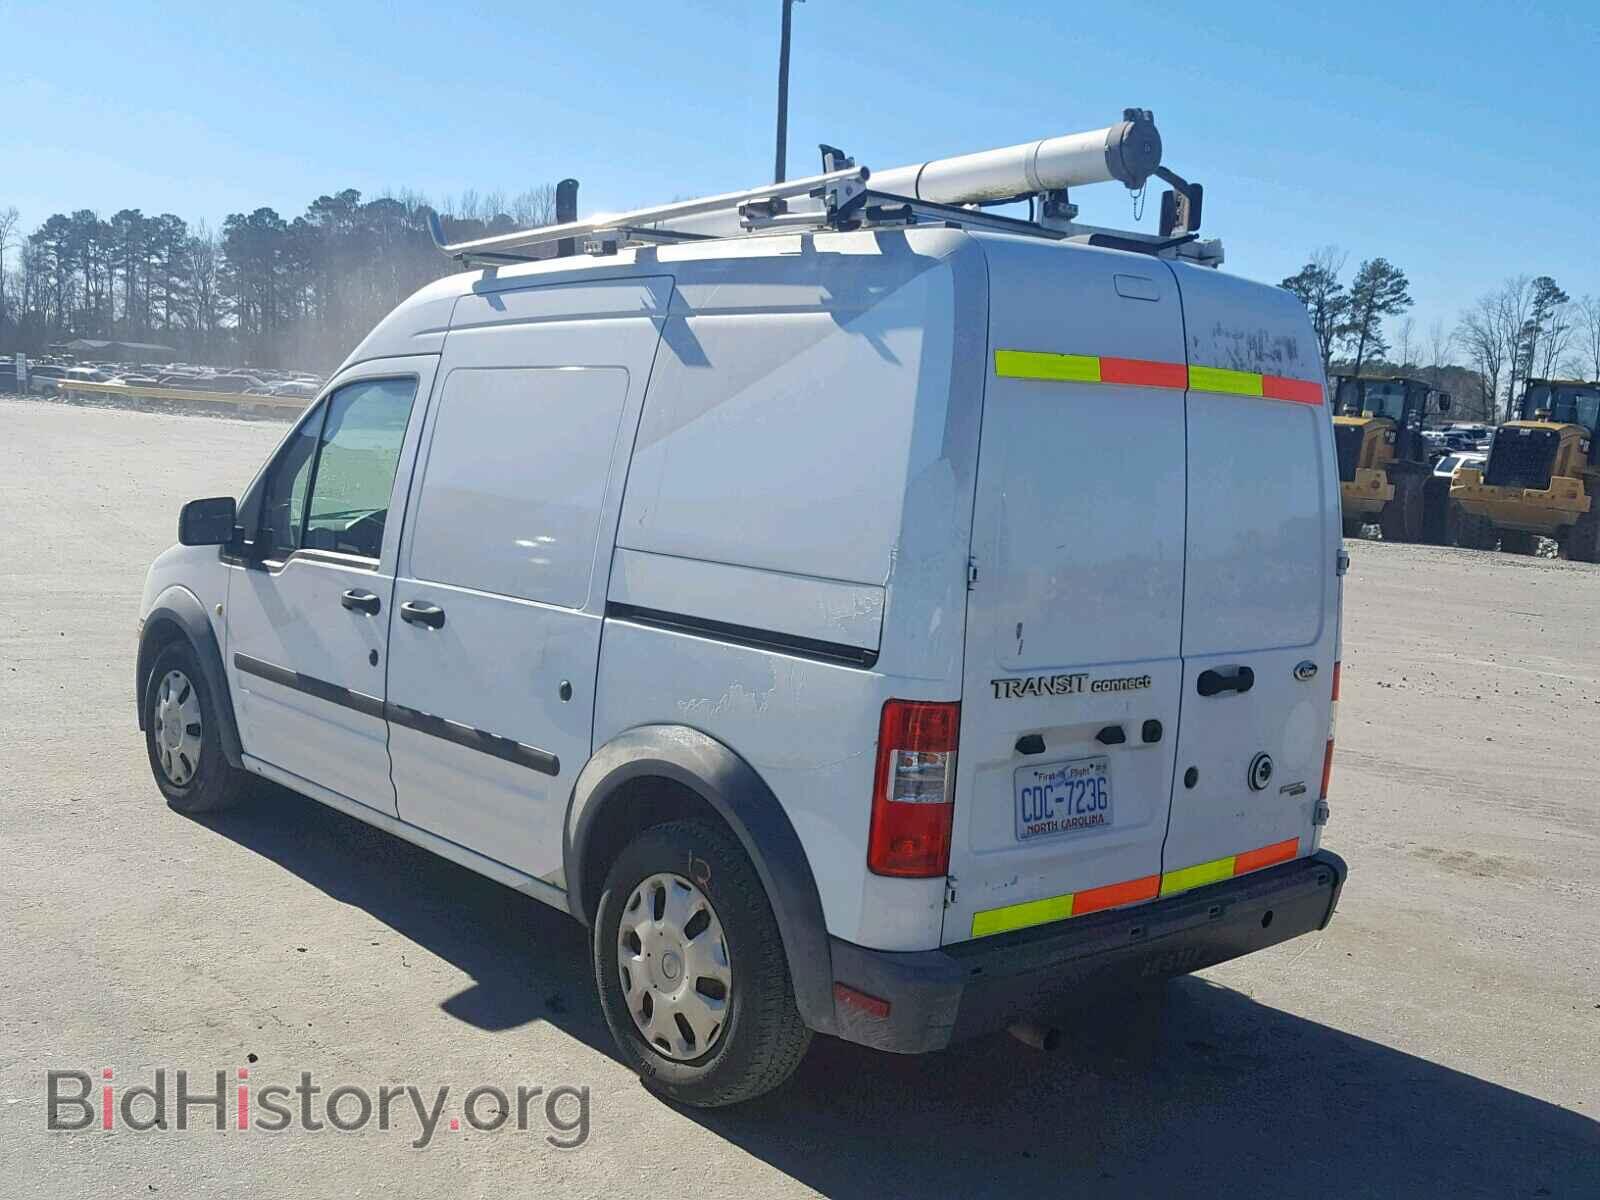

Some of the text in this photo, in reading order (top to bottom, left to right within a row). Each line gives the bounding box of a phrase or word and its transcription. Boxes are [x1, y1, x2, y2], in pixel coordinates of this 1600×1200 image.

[991, 673, 1152, 699] TRANSIT connect
[1021, 777, 1108, 822] CDC-7236
[1027, 814, 1105, 834] NORTH CAROLINA
